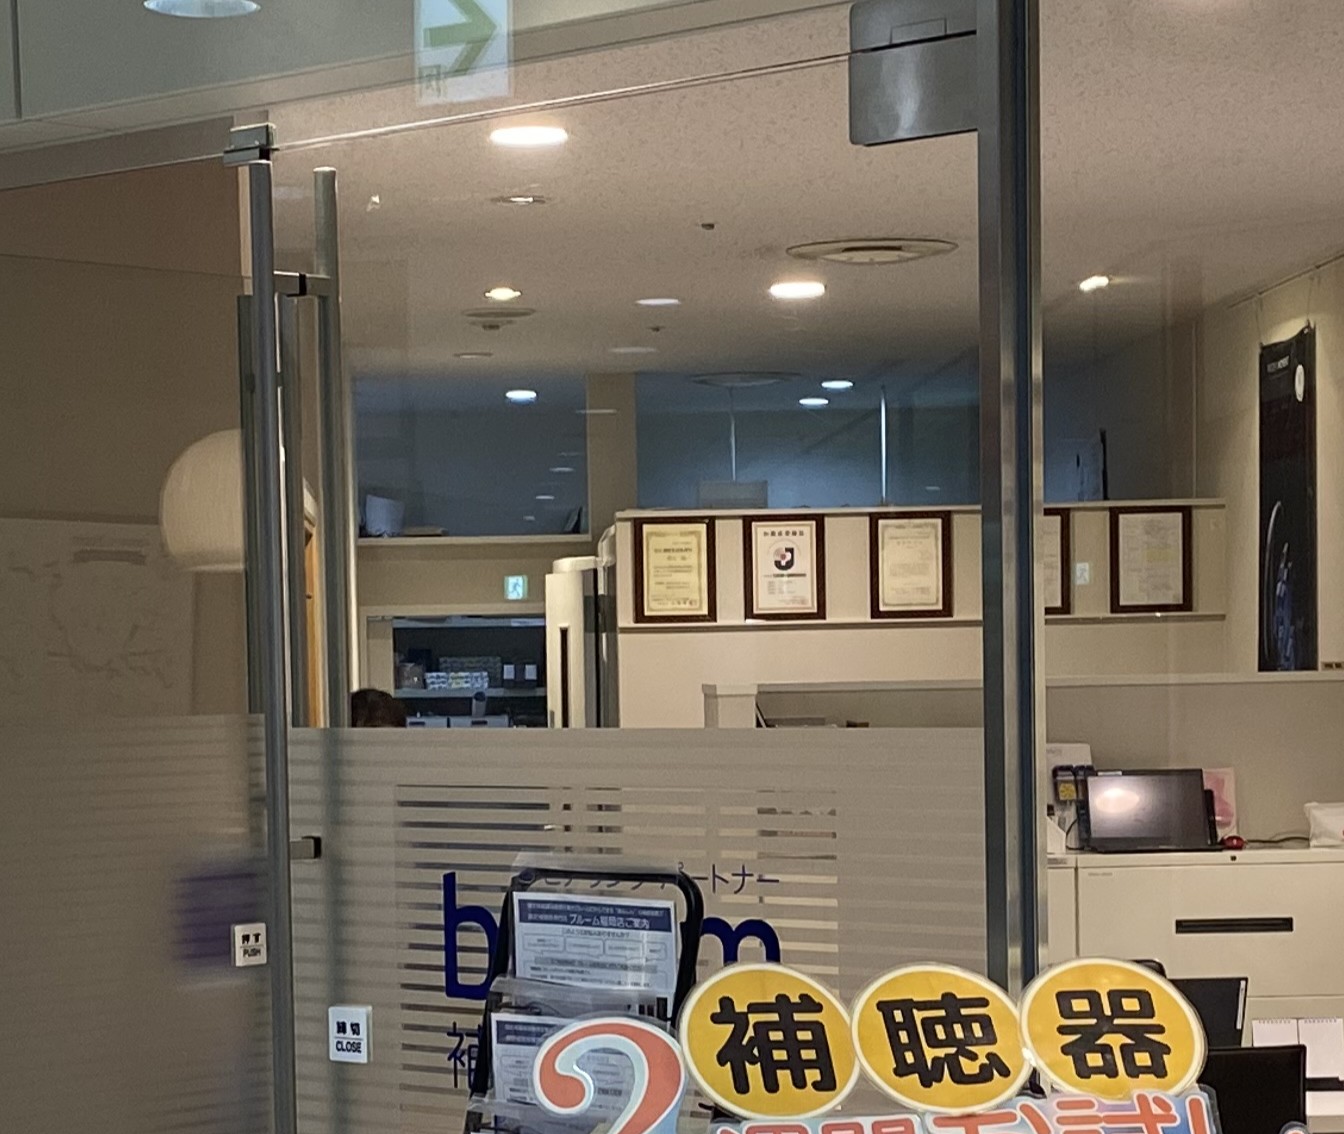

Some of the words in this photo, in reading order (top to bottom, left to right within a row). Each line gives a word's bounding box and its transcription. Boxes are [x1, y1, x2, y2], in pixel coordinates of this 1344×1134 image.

[335, 1040, 362, 1054] CLOSE
[710, 987, 1172, 1094] 補聴器
